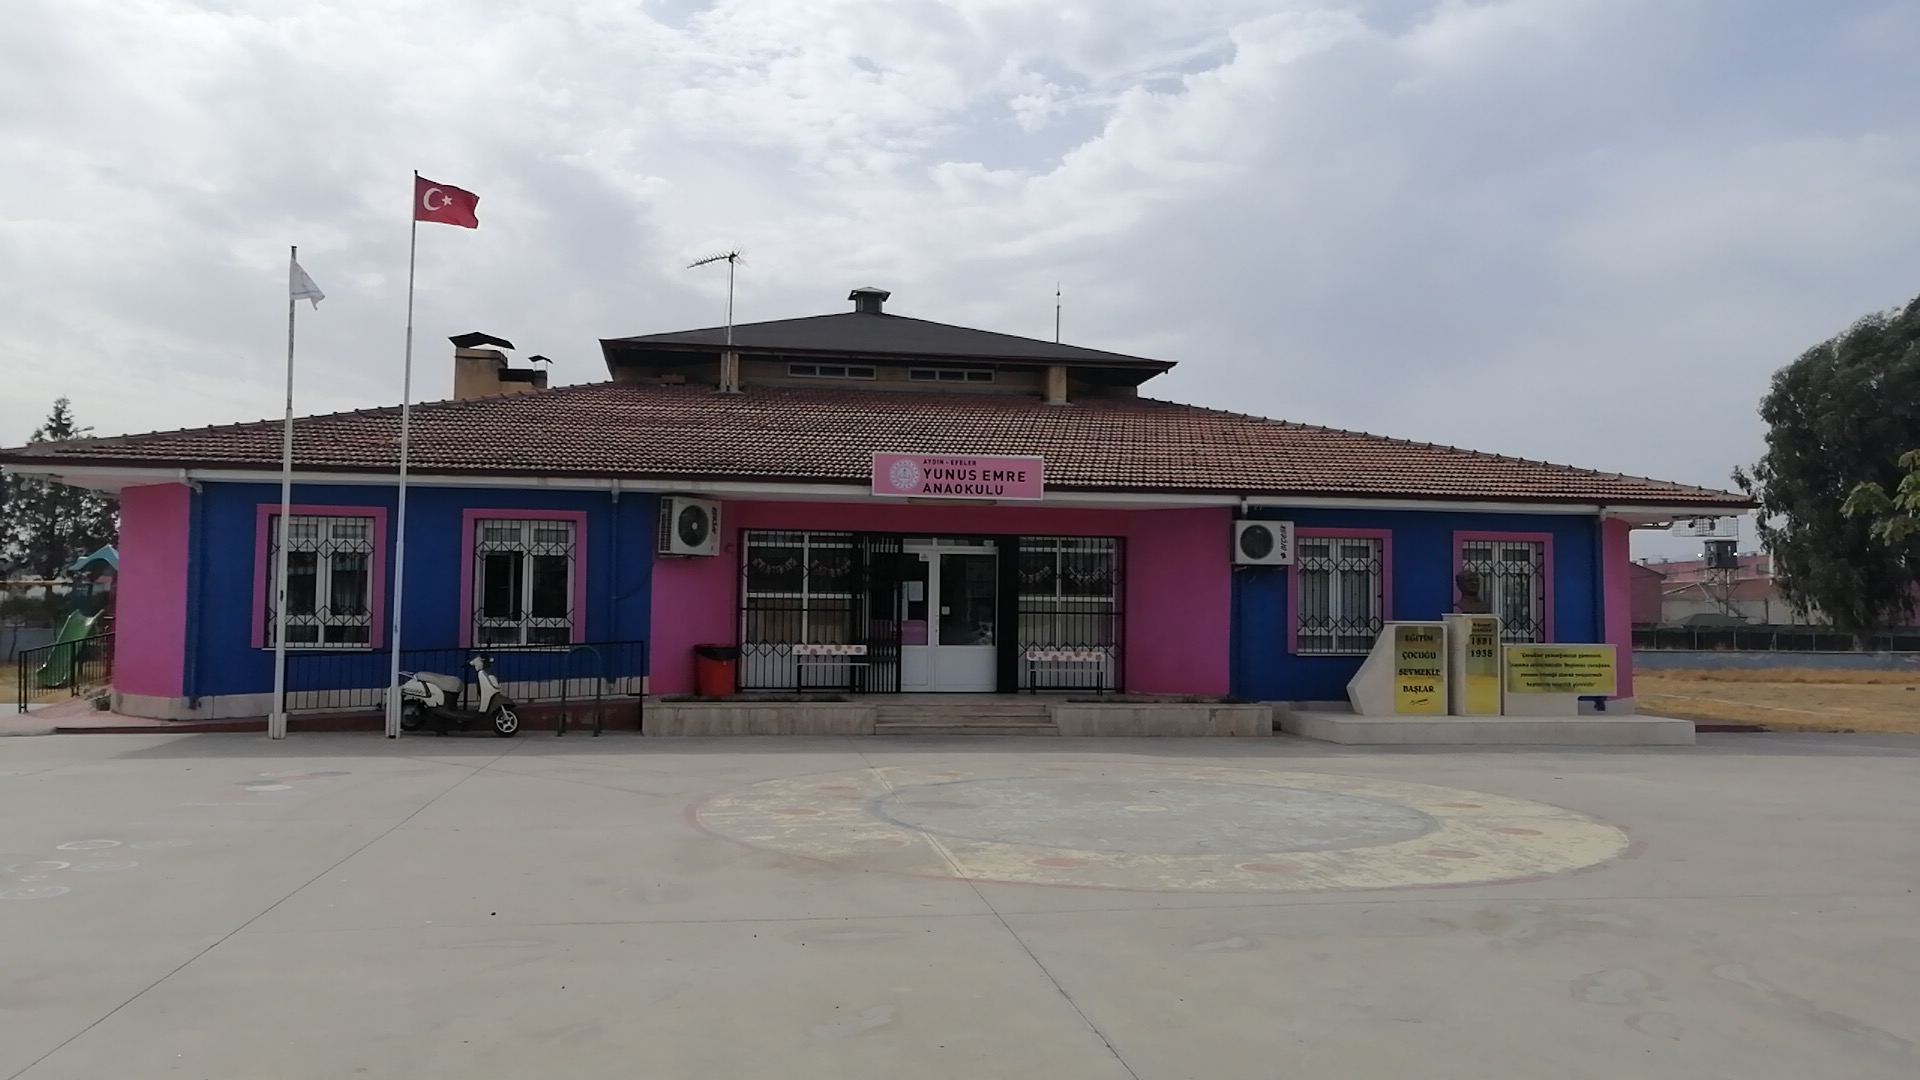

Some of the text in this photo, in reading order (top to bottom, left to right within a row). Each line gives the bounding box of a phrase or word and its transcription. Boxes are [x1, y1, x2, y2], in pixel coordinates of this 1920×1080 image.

[923, 468, 1026, 482] YUNUS EMRE
[922, 483, 1004, 495] ANAOKULU
[1471, 637, 1492, 645] 1881
[1402, 651, 1436, 660] ÇOCUĞU
[1471, 650, 1493, 658] 1938
[1399, 668, 1441, 676] SEVMEKLE
[1403, 685, 1435, 694] BAŞLAR
